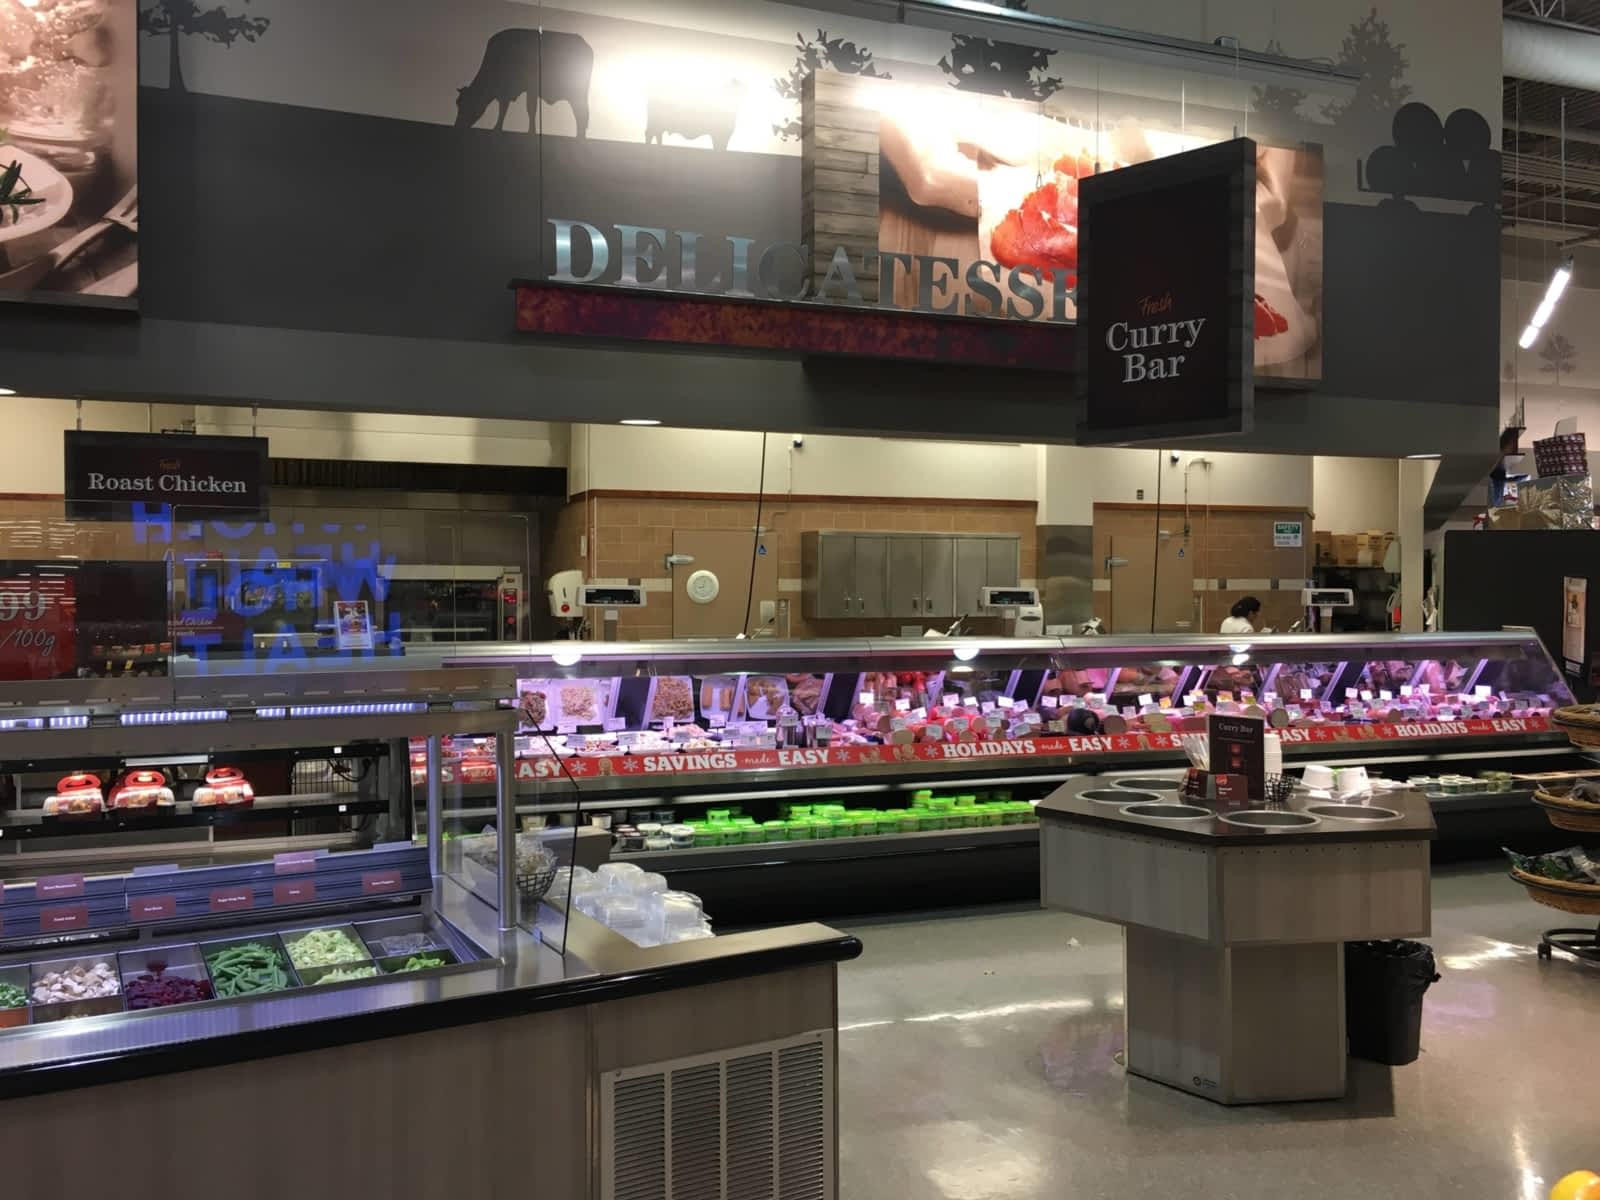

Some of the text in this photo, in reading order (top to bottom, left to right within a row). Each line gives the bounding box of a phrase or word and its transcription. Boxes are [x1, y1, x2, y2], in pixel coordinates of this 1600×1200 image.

[1106, 317, 1207, 352] Curry
[1122, 352, 1186, 383] Bar
[88, 472, 248, 494] Roast Chicken
[1269, 729, 1310, 743] ASY
[1395, 721, 1469, 738] HOLIDAYS
[1492, 718, 1527, 732] EASY
[943, 739, 1036, 758] HOLIDAYS
[1069, 736, 1113, 752] EASY
[514, 757, 562, 779] ASY
[643, 749, 829, 773] SAVINGS made EASY
